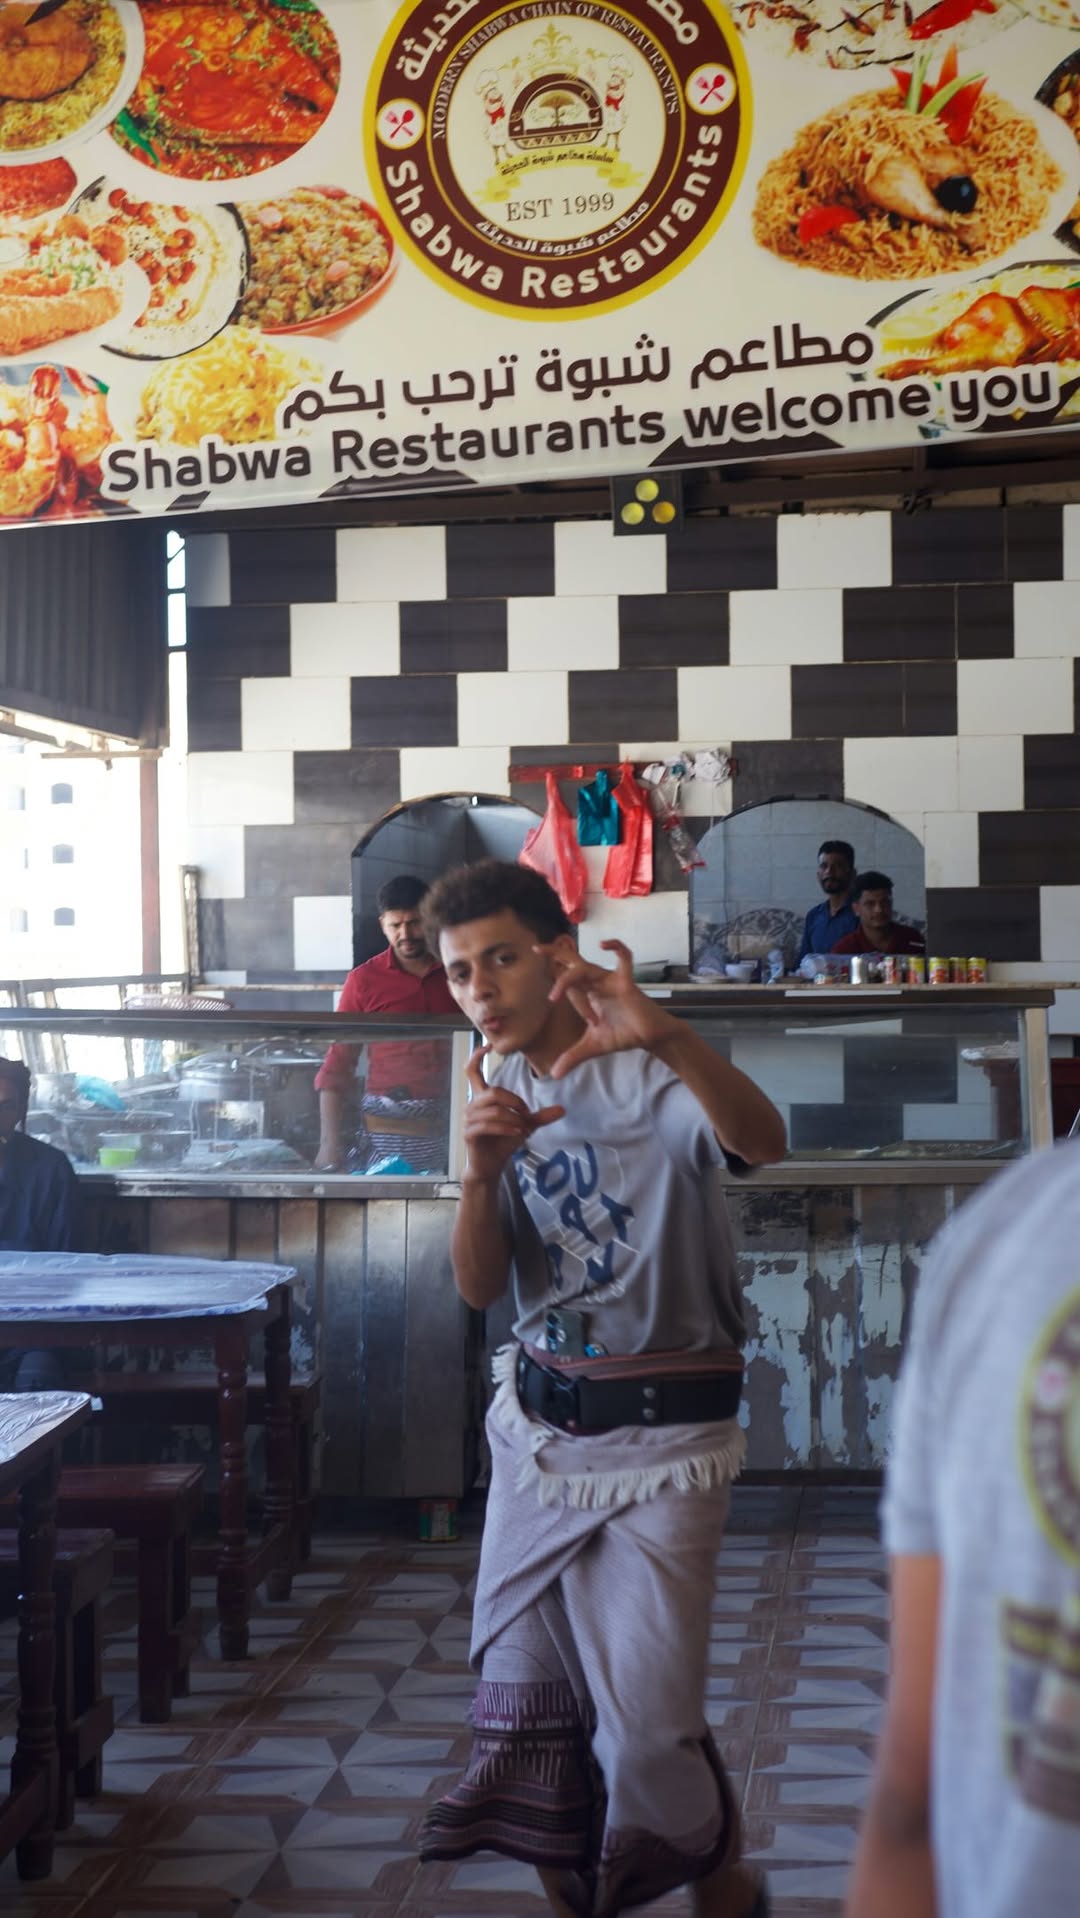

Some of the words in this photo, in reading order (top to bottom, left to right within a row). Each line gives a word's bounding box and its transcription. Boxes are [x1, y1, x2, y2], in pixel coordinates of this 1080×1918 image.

[432, 55, 463, 140] MODERN
[459, 12, 519, 59] SHABWA
[520, 2, 572, 19] CHAIN
[576, 3, 600, 17] OF
[600, 9, 680, 114] RESTAURANTS
[386, 159, 504, 291] Shabwa
[520, 124, 723, 299] Restaurants
[475, 219, 538, 253] الحديثة
[506, 198, 552, 222] EST
[562, 192, 615, 216] 1999
[597, 201, 650, 246] مطاعم
[540, 235, 595, 257] شبوة
[402, 354, 519, 416] ترحب
[535, 333, 671, 401] شبوة
[690, 322, 874, 389] مطاعم
[282, 370, 386, 429] بكم
[108, 441, 312, 493] Shabwa
[332, 404, 666, 473] Restaurants
[682, 382, 931, 438] welcome
[949, 370, 1052, 423] you
